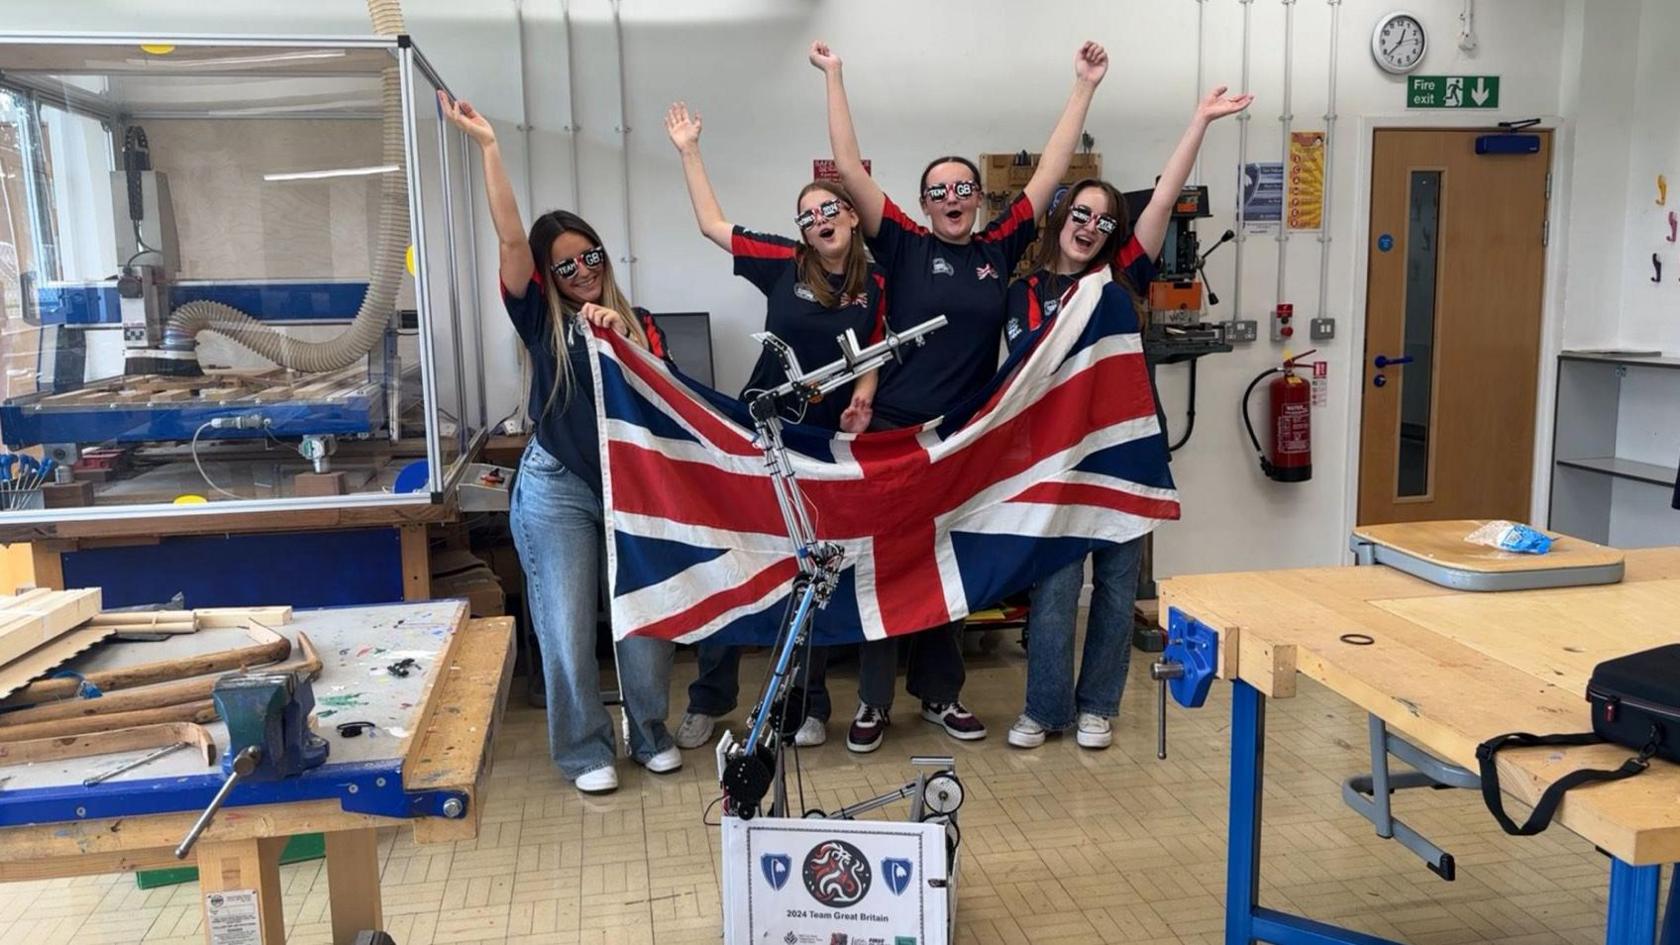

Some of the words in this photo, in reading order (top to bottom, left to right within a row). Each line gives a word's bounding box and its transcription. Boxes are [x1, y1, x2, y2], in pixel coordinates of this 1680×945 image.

[1413, 79, 1436, 90] Fire
[1413, 93, 1435, 104] exit
[930, 189, 946, 197] TEAM
[957, 184, 971, 196] GB
[557, 262, 577, 274] TEAM
[585, 252, 600, 265] GB
[787, 909, 807, 918] 2024
[810, 910, 832, 920] Team
[834, 912, 858, 922] Great
[860, 913, 889, 923] Britain
